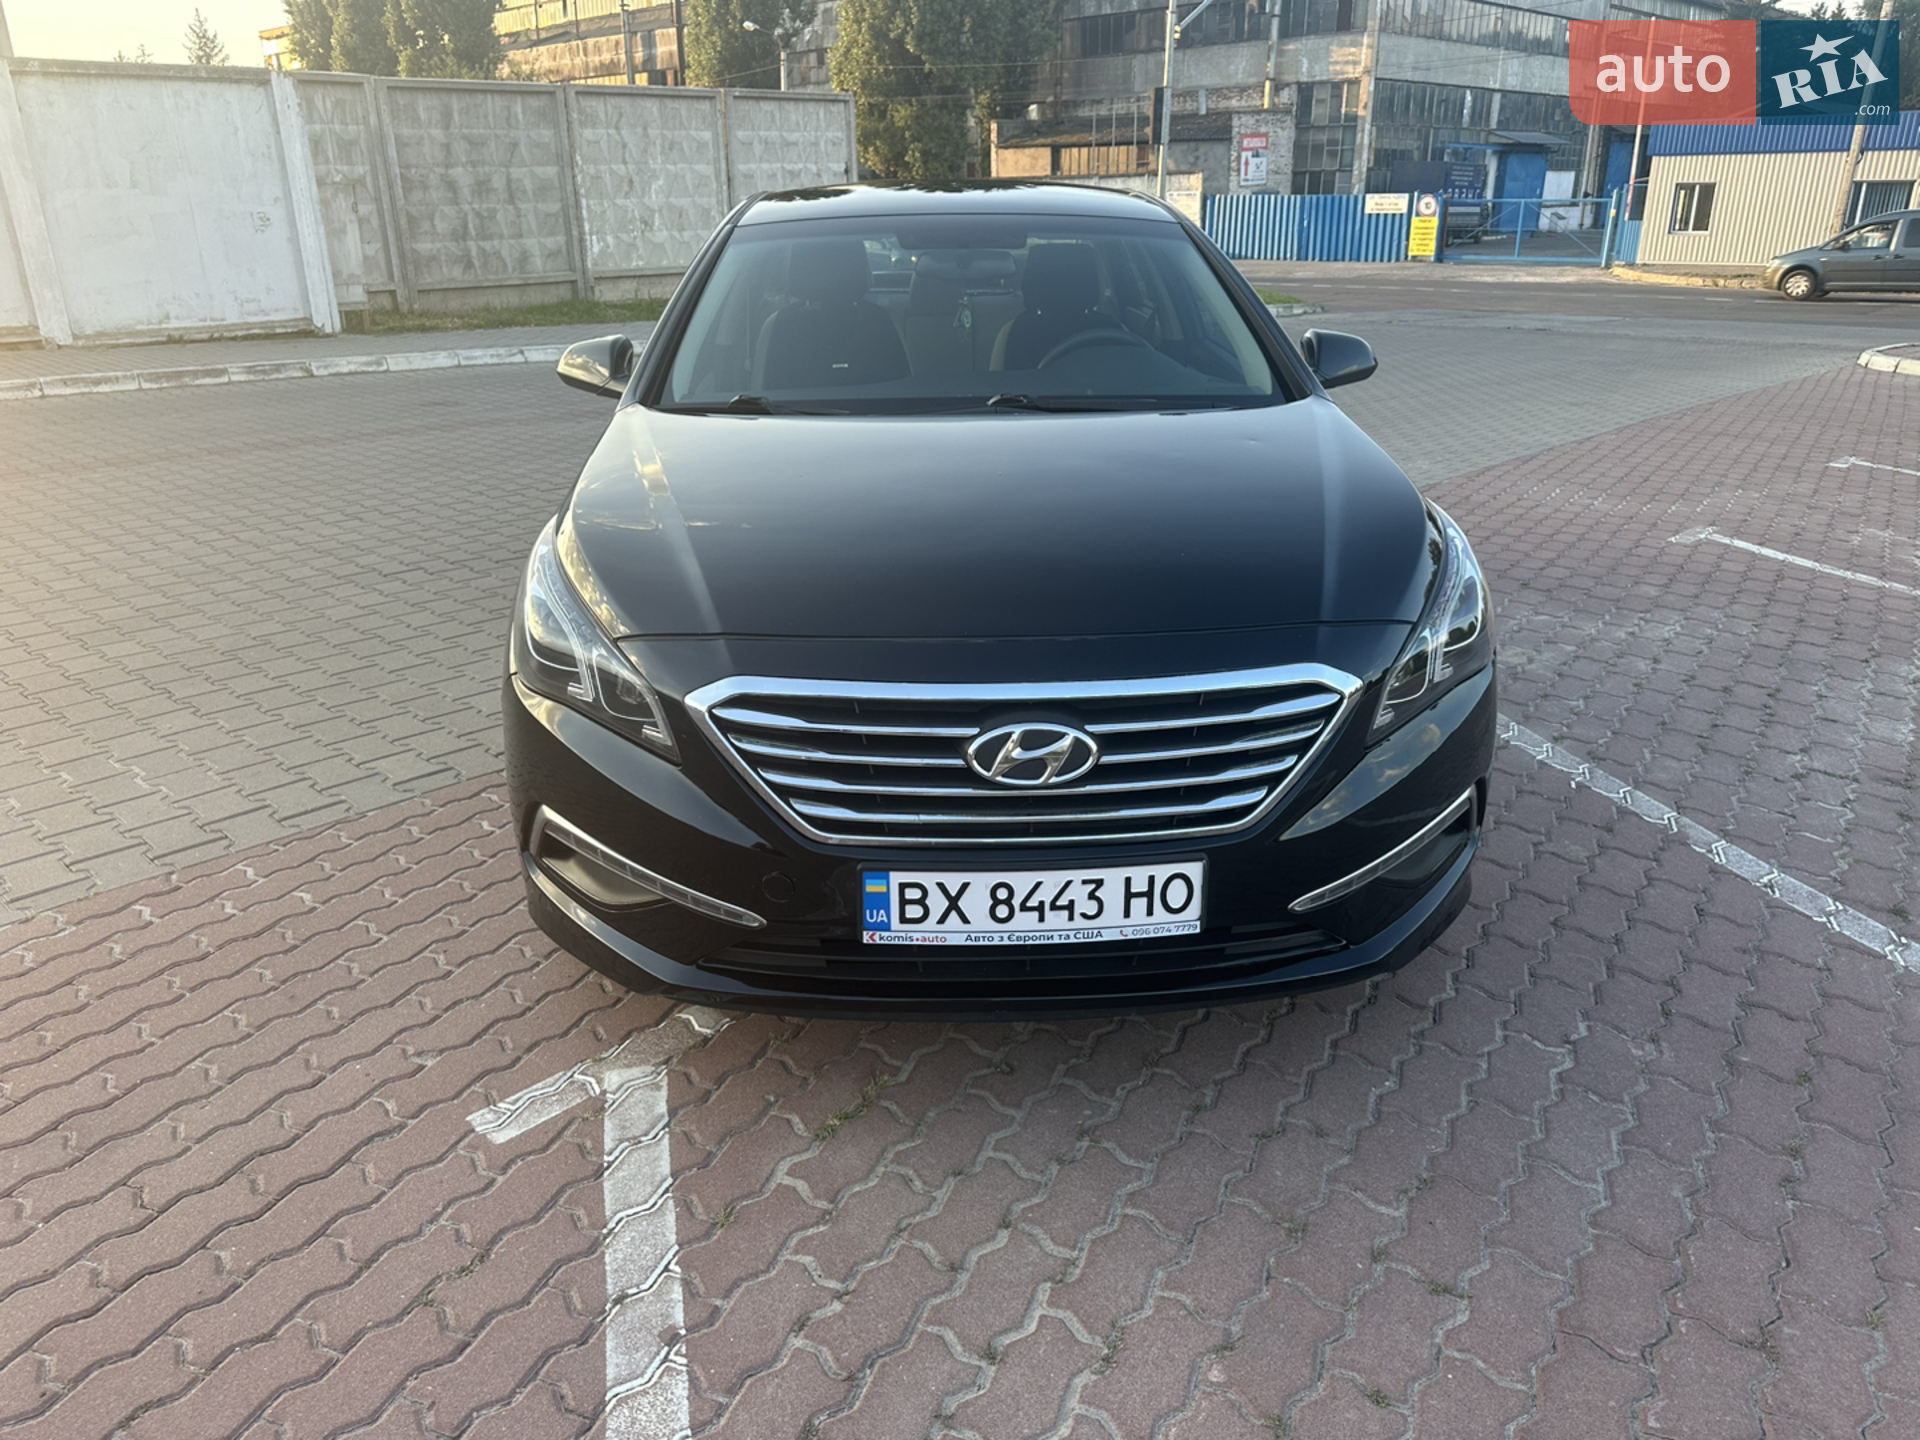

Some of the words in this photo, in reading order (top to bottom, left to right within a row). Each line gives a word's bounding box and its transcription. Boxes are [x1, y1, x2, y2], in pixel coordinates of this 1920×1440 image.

[897, 881, 971, 925] BX
[988, 878, 1104, 925] 8443
[1123, 872, 1194, 919] HO
[866, 909, 888, 924] UA
[964, 933, 994, 944] Авто
[997, 935, 1005, 943] з
[1007, 932, 1053, 945] Європи
[1056, 933, 1071, 943] та
[1073, 930, 1103, 941] США
[1131, 927, 1151, 937] 096
[1152, 926, 1172, 935] 074
[1173, 923, 1199, 933] 7779
